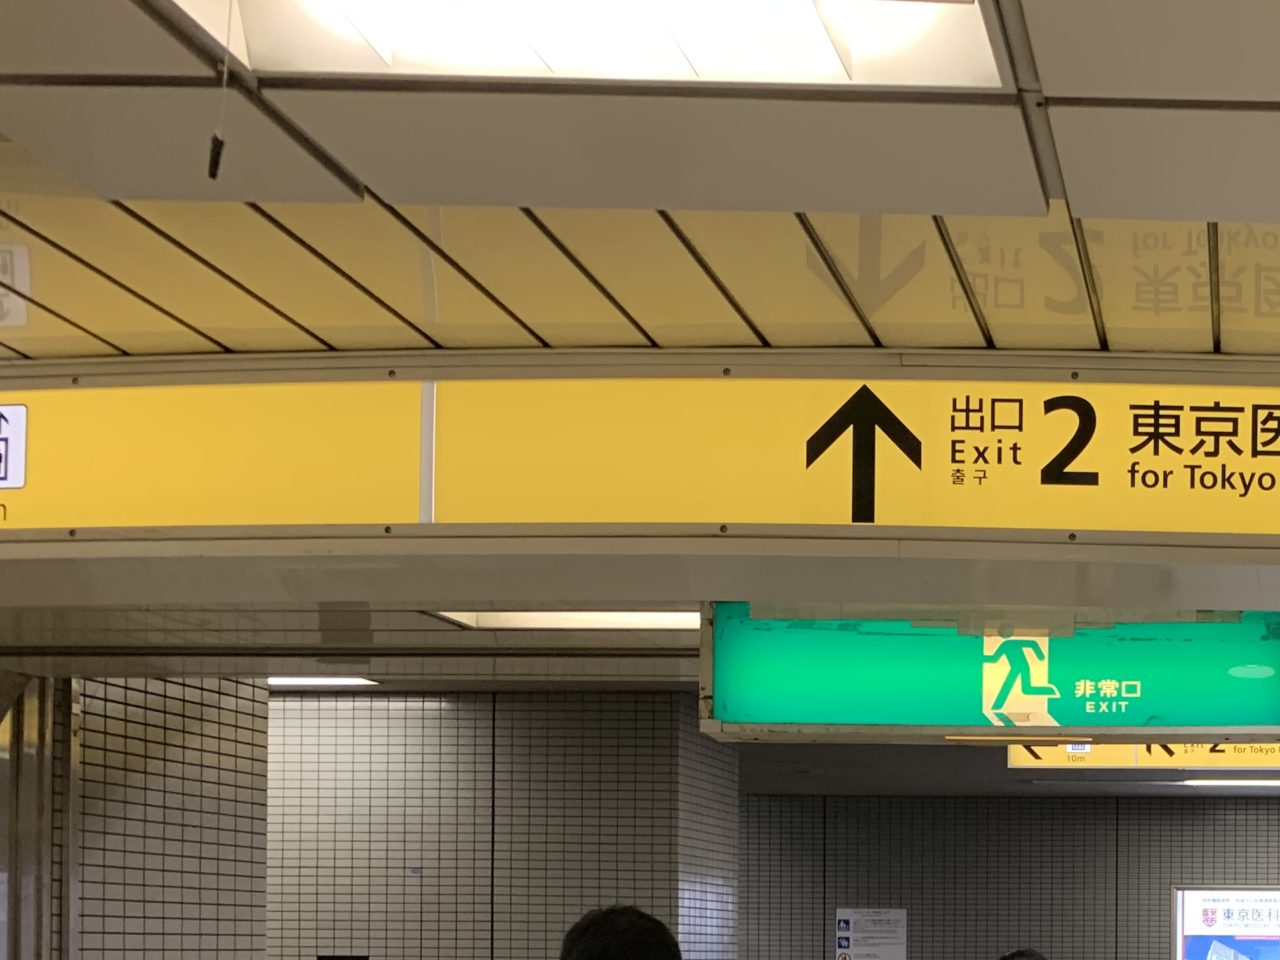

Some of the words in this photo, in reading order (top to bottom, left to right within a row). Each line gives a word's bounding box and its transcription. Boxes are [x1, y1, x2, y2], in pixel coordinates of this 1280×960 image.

[951, 395, 1023, 432] 出口
[1041, 396, 1099, 486] 2
[951, 439, 1022, 465] Exit
[951, 468, 988, 486] 출구
[1128, 461, 1173, 488] for
[1184, 464, 1276, 497] Tokyo
[1074, 679, 1142, 698] 非常口
[1086, 701, 1129, 713] EXIT
[1067, 755, 1086, 763] 10m
[1233, 745, 1246, 754] for
[1250, 745, 1276, 755] Tokyo
